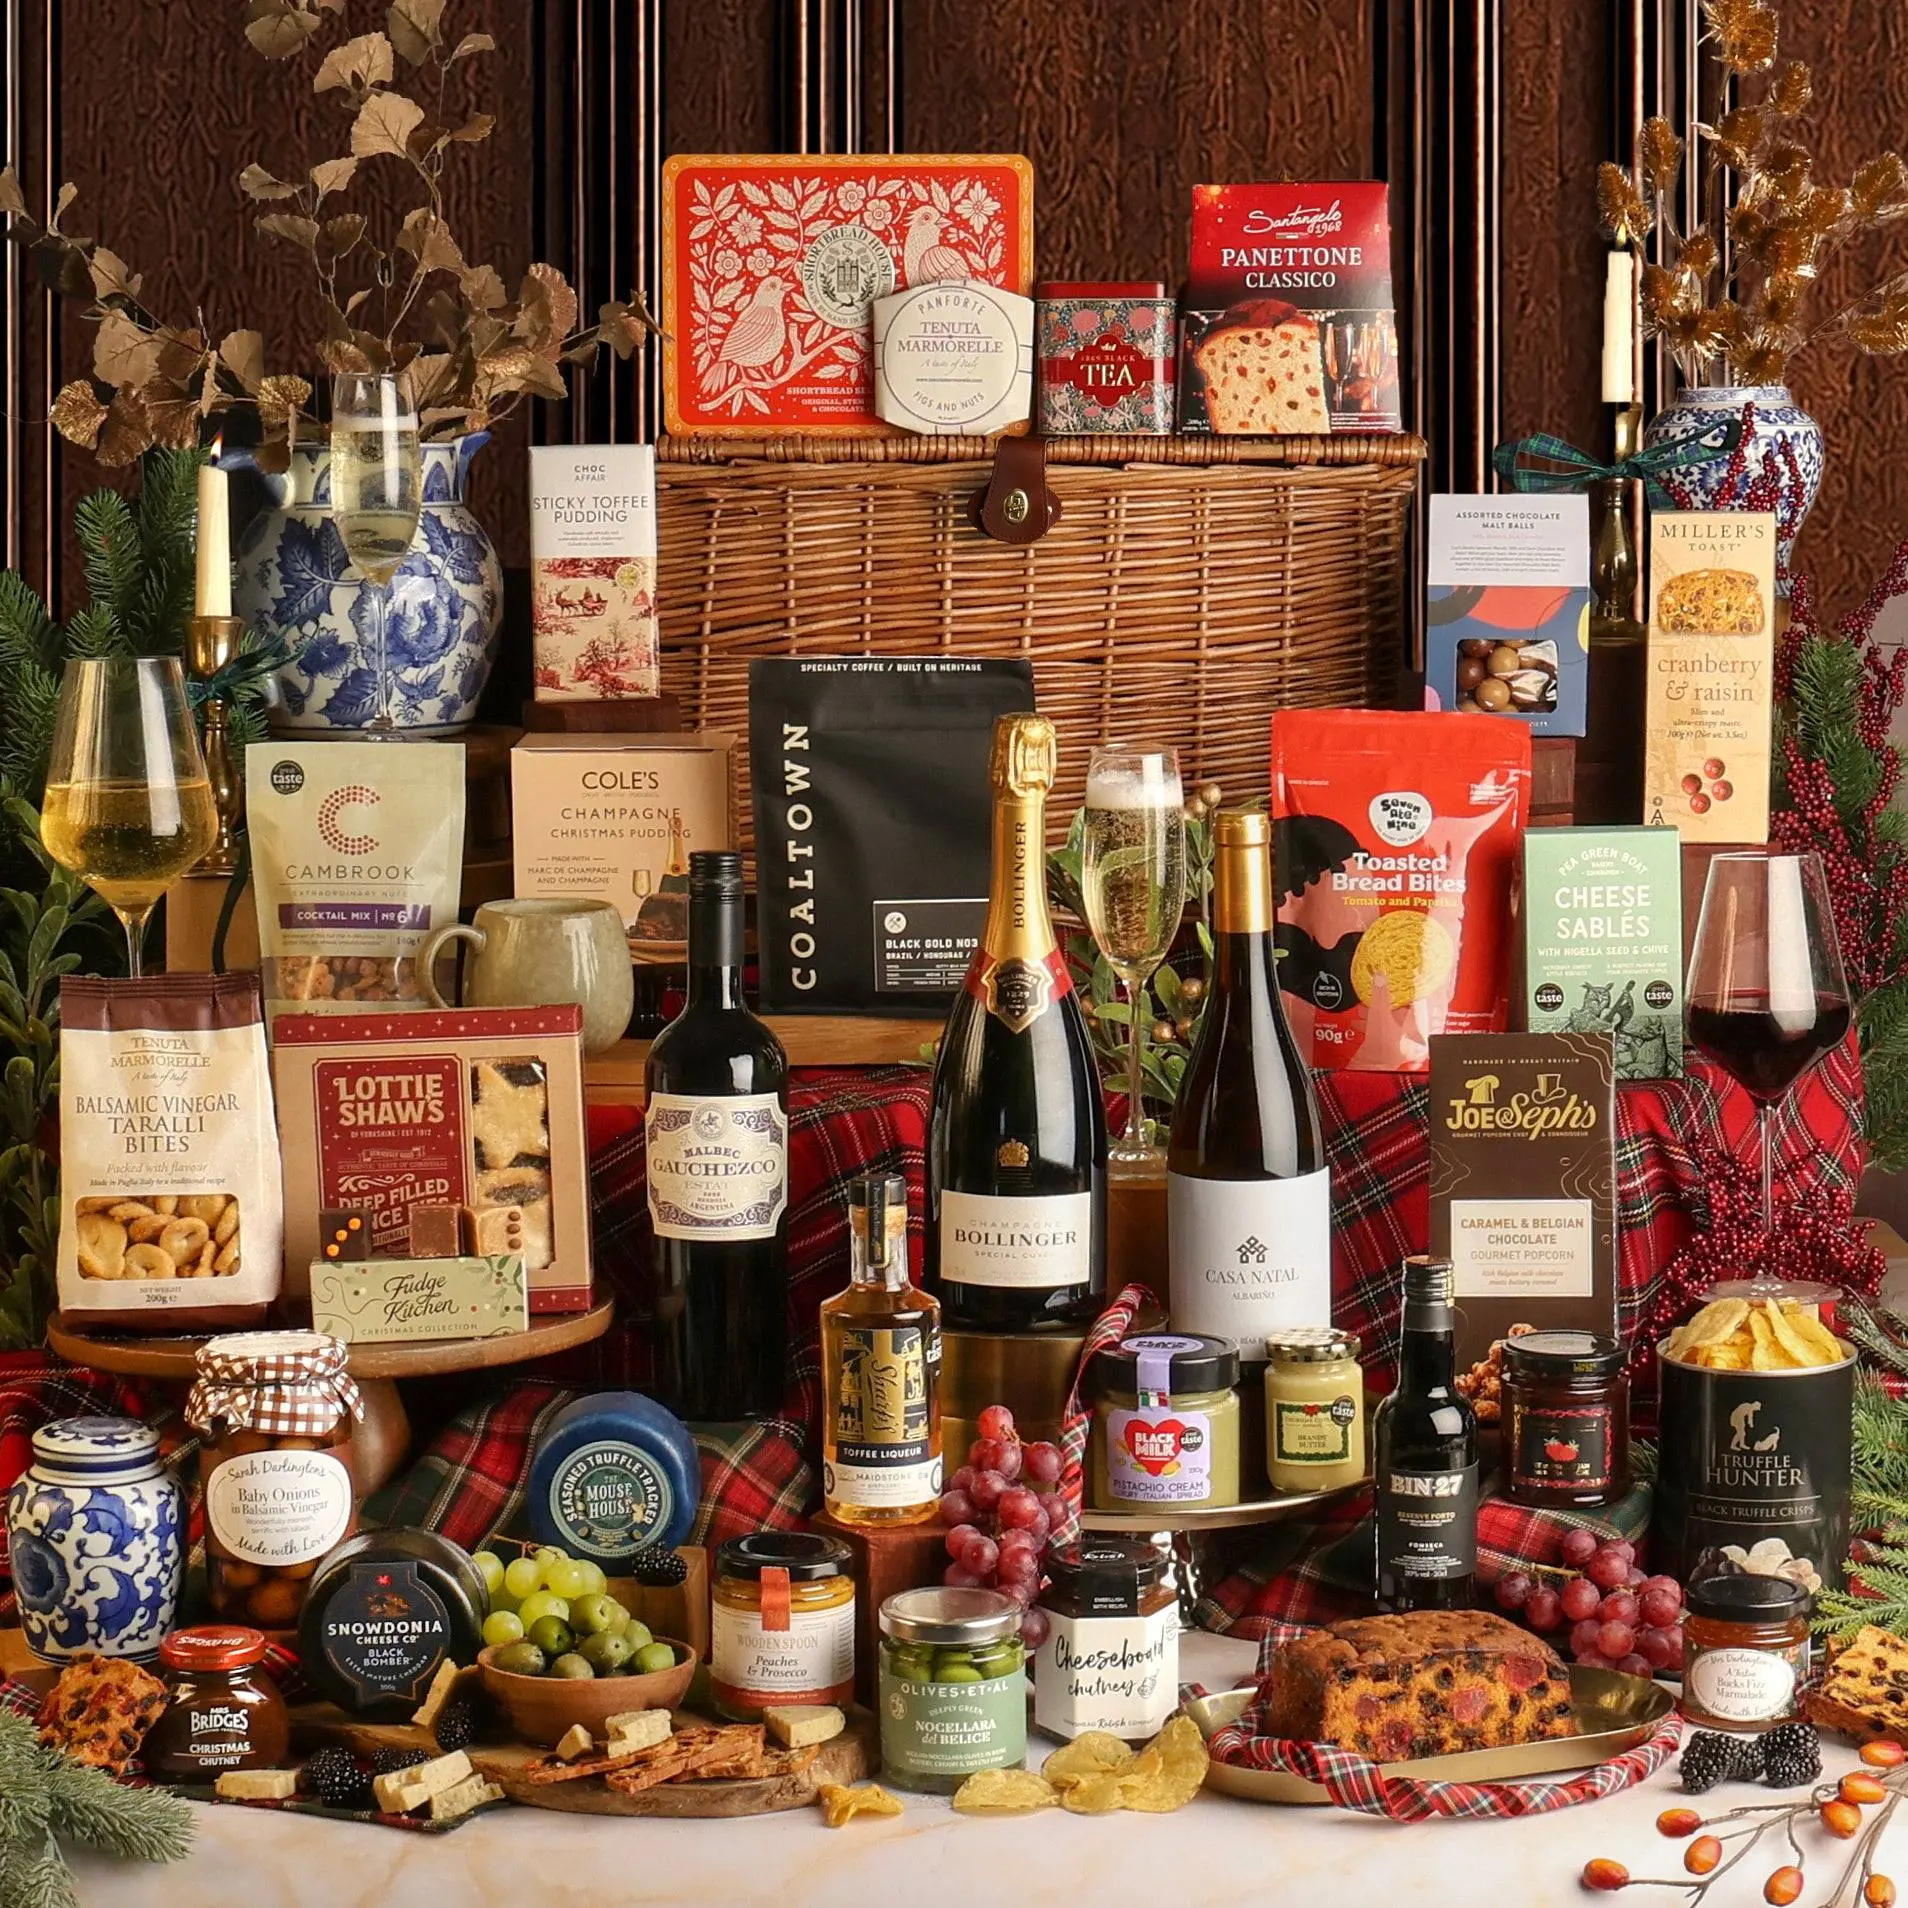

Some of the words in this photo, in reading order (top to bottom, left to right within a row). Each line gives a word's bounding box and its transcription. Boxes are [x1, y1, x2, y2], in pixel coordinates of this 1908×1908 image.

[1243, 199, 1342, 234] Santangelo
[1314, 220, 1342, 237] 1968
[804, 227, 868, 281] SHORTBREAD
[1221, 247, 1362, 268] PANETTONE
[1245, 272, 1336, 289] CLASSICO
[918, 294, 986, 316] PANFORTE
[920, 321, 981, 335] TENUTA
[897, 341, 1004, 354] MARMORELLE
[1080, 364, 1135, 388] TEA
[787, 387, 854, 395] SHORTBREAD
[912, 391, 932, 407] FIGS
[936, 402, 957, 412] AND
[961, 392, 985, 410] NUTS
[574, 465, 606, 473] CHOC
[574, 474, 606, 482] AFFAIR
[533, 497, 585, 510] STICKY
[593, 496, 649, 509] TOFFEE
[554, 510, 628, 523] PUDDING
[1506, 512, 1561, 520] CHOCOLATE
[1660, 524, 1764, 539] MILLER'S
[800, 663, 849, 672] SPECIALTY
[851, 663, 884, 672] COFFEE
[896, 663, 922, 671] BUILT
[925, 663, 937, 671] ON
[940, 663, 982, 672] HERITAGE
[1658, 653, 1762, 680] cranberry
[1666, 680, 1689, 701] &
[1694, 682, 1754, 701] raisin
[273, 773, 303, 784] taste
[582, 771, 660, 790] COLE'S
[1380, 798, 1422, 813] Seven
[561, 808, 682, 820] CHAMPAGNE
[551, 829, 625, 839] CHRISTMAS
[630, 828, 692, 839] PUDDING
[783, 723, 818, 990] COALTOWN
[1353, 852, 1447, 872] Toasted
[1558, 858, 1579, 876] PEA
[1580, 848, 1618, 860] GREEN
[1621, 851, 1648, 875] BOAT
[285, 865, 416, 881] CAMBROOK
[566, 867, 619, 875] CHAMPAGNE
[1013, 822, 1027, 929] BOLLINGER
[559, 877, 610, 885] CHAMPAGNE
[1332, 874, 1402, 892] Bread
[1408, 873, 1466, 893] Bites
[1342, 895, 1386, 906] Tomato
[1389, 895, 1411, 906] and
[1554, 885, 1652, 909] CHEESE
[297, 911, 348, 921] COCKTAIL
[350, 911, 371, 921] MIX
[1556, 908, 1651, 940] SABLÉS
[886, 938, 921, 949] BLACK
[924, 938, 953, 949] GOLD
[1538, 947, 1561, 957] WITH
[1563, 946, 1603, 956] NIGELLA
[1605, 946, 1630, 955] SEED
[1641, 944, 1670, 954] CHIVE
[1536, 994, 1563, 1003] taste
[1646, 991, 1673, 1001] taste
[131, 1037, 189, 1050] TENUTA
[1316, 1029, 1343, 1044] 90g
[110, 1056, 212, 1068] MARMORELLE
[333, 1073, 445, 1101] LOTTIE
[76, 1095, 160, 1114] BALSAMIC
[163, 1093, 240, 1114] VINEGAR
[339, 1099, 445, 1127] SHAW'S
[1446, 1099, 1495, 1130] JOE
[107, 1115, 204, 1135] TARALLI
[125, 1135, 190, 1154] BITES
[684, 1146, 741, 1159] MALBEC
[107, 1162, 144, 1174] Packed
[146, 1161, 169, 1173] with
[170, 1159, 208, 1175] flavour
[653, 1158, 777, 1177] GAUCHEZCO
[389, 1177, 450, 1206] FILLED
[689, 1202, 735, 1211] ARGENTINA
[1460, 1218, 1518, 1229] CARAMEL
[1520, 1218, 1530, 1229] &
[1532, 1218, 1584, 1229] BELGIAN
[955, 1228, 1077, 1247] BOLLINGER
[1487, 1233, 1557, 1245] CHOCOLATE
[974, 1250, 1018, 1259] SPECIAL
[1470, 1250, 1522, 1261] GOURMET
[1524, 1250, 1575, 1261] POPCORN
[1205, 1268, 1247, 1285] CASA
[1250, 1267, 1300, 1285] NATAL
[383, 1271, 447, 1304] Fudge
[383, 1292, 460, 1326] Kitchen
[361, 1326, 414, 1336] CHRISTMAS
[418, 1323, 478, 1333] COLLECTION
[1332, 1405, 1355, 1418] taste
[1135, 1432, 1175, 1443] BLACK
[843, 1447, 878, 1459] TOFFEE
[880, 1446, 922, 1459] LIQUEUR
[1135, 1443, 1176, 1456] MILK
[1721, 1454, 1791, 1469] TRUFFLE
[227, 1459, 260, 1483] Sarah
[1706, 1467, 1806, 1487] HUNTER
[604, 1475, 618, 1483] THE
[238, 1488, 269, 1504] Baby
[272, 1486, 321, 1502] Onions
[562, 1461, 588, 1522] SEASONED
[587, 1452, 642, 1473] TRUFFLE
[639, 1468, 660, 1525] TRACKER
[585, 1482, 633, 1501] MOUSE
[1168, 1482, 1204, 1493] CREAM
[1143, 1491, 1172, 1500] ITALIAN
[1177, 1491, 1204, 1499] SPREAD
[242, 1503, 288, 1516] Balsamic
[290, 1500, 330, 1516] Vinegar
[589, 1499, 633, 1520] HOUSE
[1732, 1505, 1777, 1517] TRUFFLE
[1779, 1504, 1815, 1515] CRISPS
[234, 1535, 269, 1556] Made
[271, 1542, 300, 1557] with
[327, 1620, 444, 1637] SNOWDONIA
[356, 1635, 399, 1645] CHEESE
[737, 1634, 781, 1649] WOODEN
[783, 1635, 819, 1649] SPOON
[1055, 1623, 1164, 1671] Cheeseboard
[368, 1648, 405, 1658] BLACK
[346, 1656, 366, 1676] EXTRA
[366, 1673, 397, 1681] MATURE
[399, 1655, 429, 1679] CHEDDAR
[363, 1657, 410, 1667] BOMBER
[755, 1655, 800, 1667] Peaches
[760, 1666, 808, 1678] Prosecco
[1067, 1677, 1135, 1698] chutney
[1717, 1677, 1745, 1687] Bucks
[1716, 1688, 1768, 1699] Marmalade
[209, 1706, 230, 1715] MRS
[928, 1705, 958, 1717] DEEPLY
[958, 1704, 985, 1716] GREEN
[190, 1708, 249, 1733] BRIDGES
[915, 1718, 997, 1733] NOCELLARA
[1097, 1717, 1126, 1729] Relish
[921, 1733, 938, 1745] del
[940, 1731, 992, 1745] BELICE
[189, 1741, 252, 1754] CHRISTMAS
[199, 1755, 242, 1766] CHUTNEY
